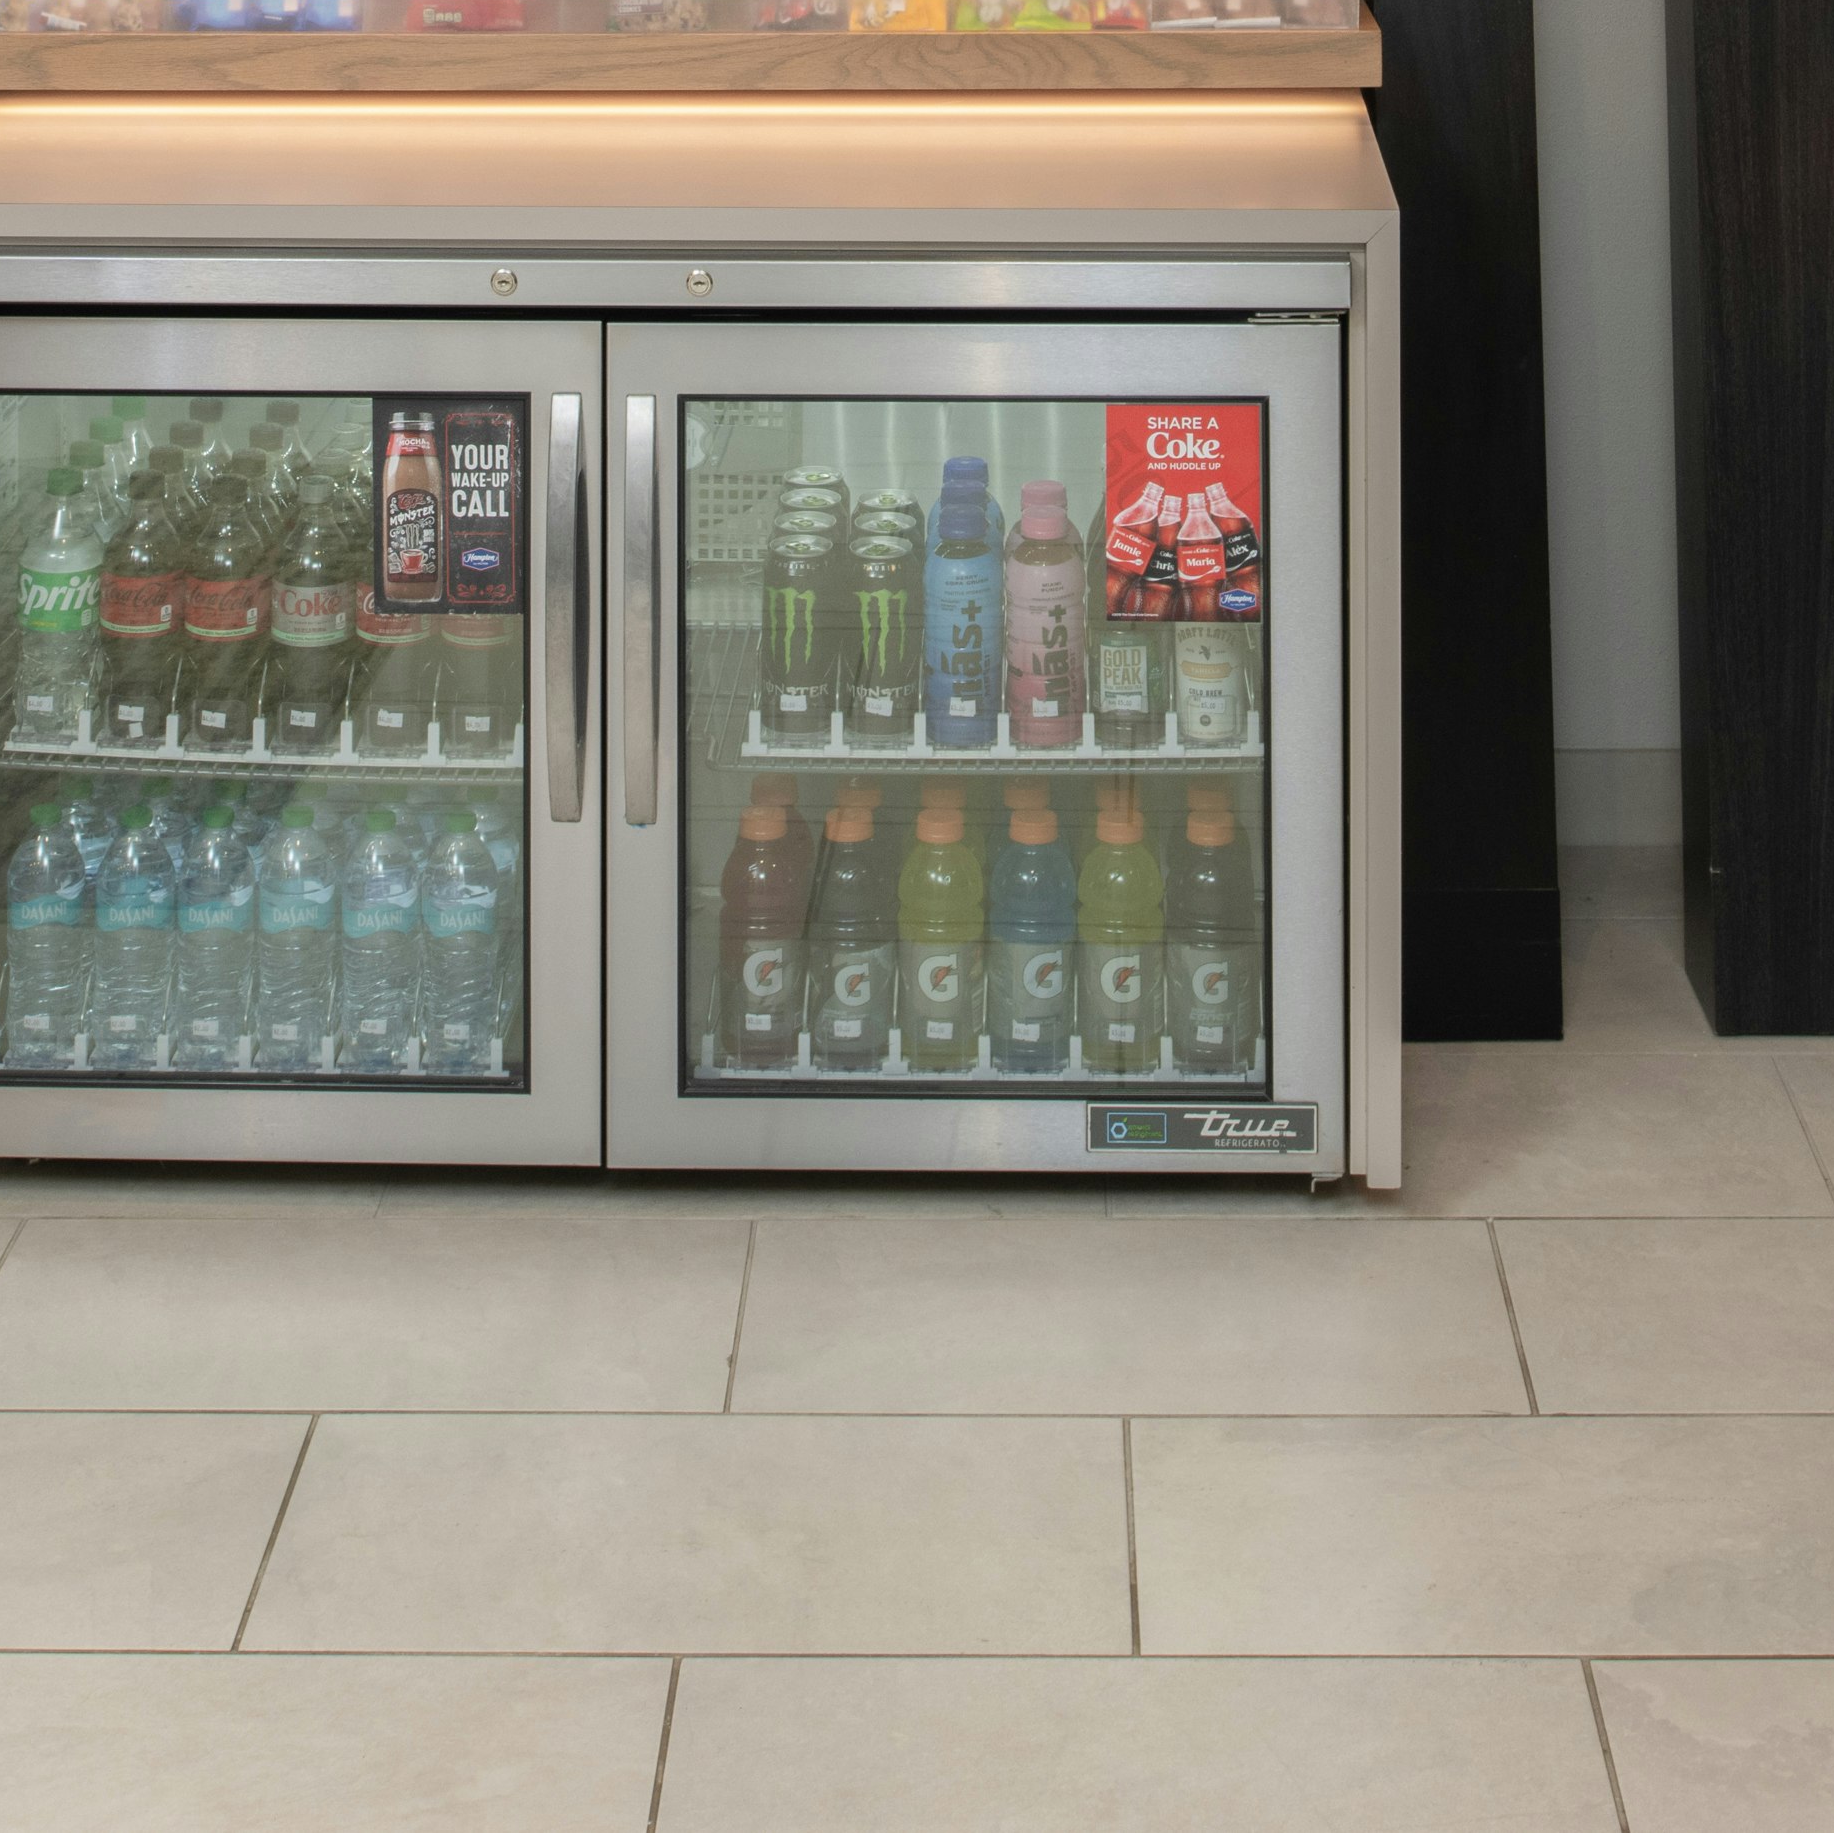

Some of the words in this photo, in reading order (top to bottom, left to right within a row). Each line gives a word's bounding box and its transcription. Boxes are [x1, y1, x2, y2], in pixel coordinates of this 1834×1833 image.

[1147, 417, 1202, 430] SHARE
[1207, 417, 1219, 430] A
[1146, 431, 1220, 459] Coke
[451, 444, 509, 470] YOUR
[451, 472, 509, 488] WAKE-UP
[452, 490, 509, 517] CALL
[1113, 538, 1142, 557] Jamie
[1186, 557, 1215, 567] Maria
[279, 589, 341, 616] Coke
[1104, 649, 1141, 666] GOLD
[1104, 668, 1142, 684] PEAK
[109, 904, 155, 927] DASANI
[188, 904, 234, 929] DASANI
[272, 904, 319, 927] DASANI
[357, 907, 404, 931] DASANI
[439, 906, 486, 931] DASANI
